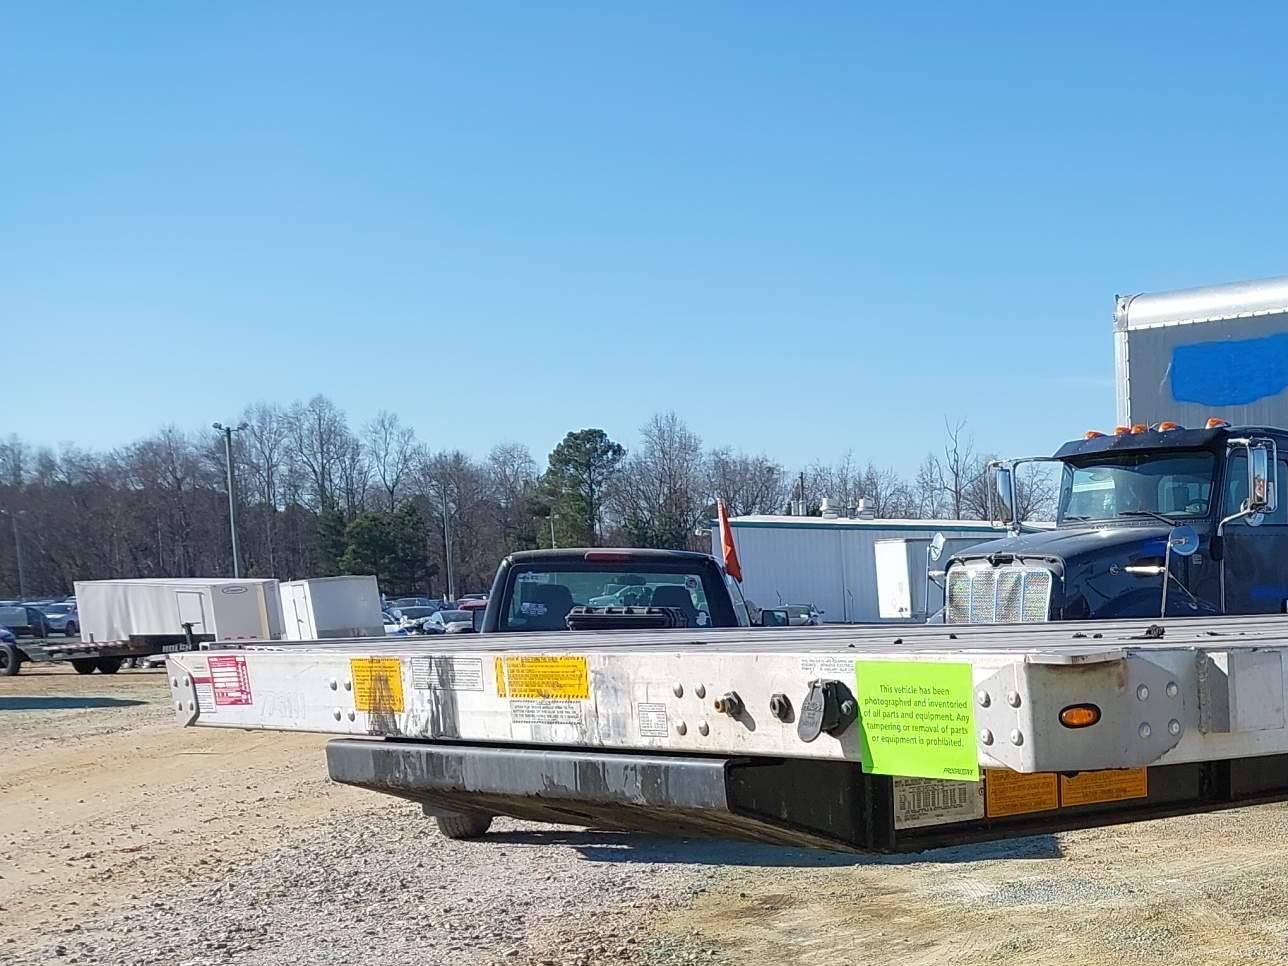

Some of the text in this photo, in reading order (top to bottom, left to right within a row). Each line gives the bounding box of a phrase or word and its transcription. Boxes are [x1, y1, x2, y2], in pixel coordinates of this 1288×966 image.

[880, 684, 950, 695] This vehicle has been
[864, 696, 968, 709] photographed and inventoried
[863, 709, 970, 724] of all parts and equipment. Any
[866, 722, 968, 736] tampering or removal of parts
[871, 735, 964, 747] or equipment is prohibited.
